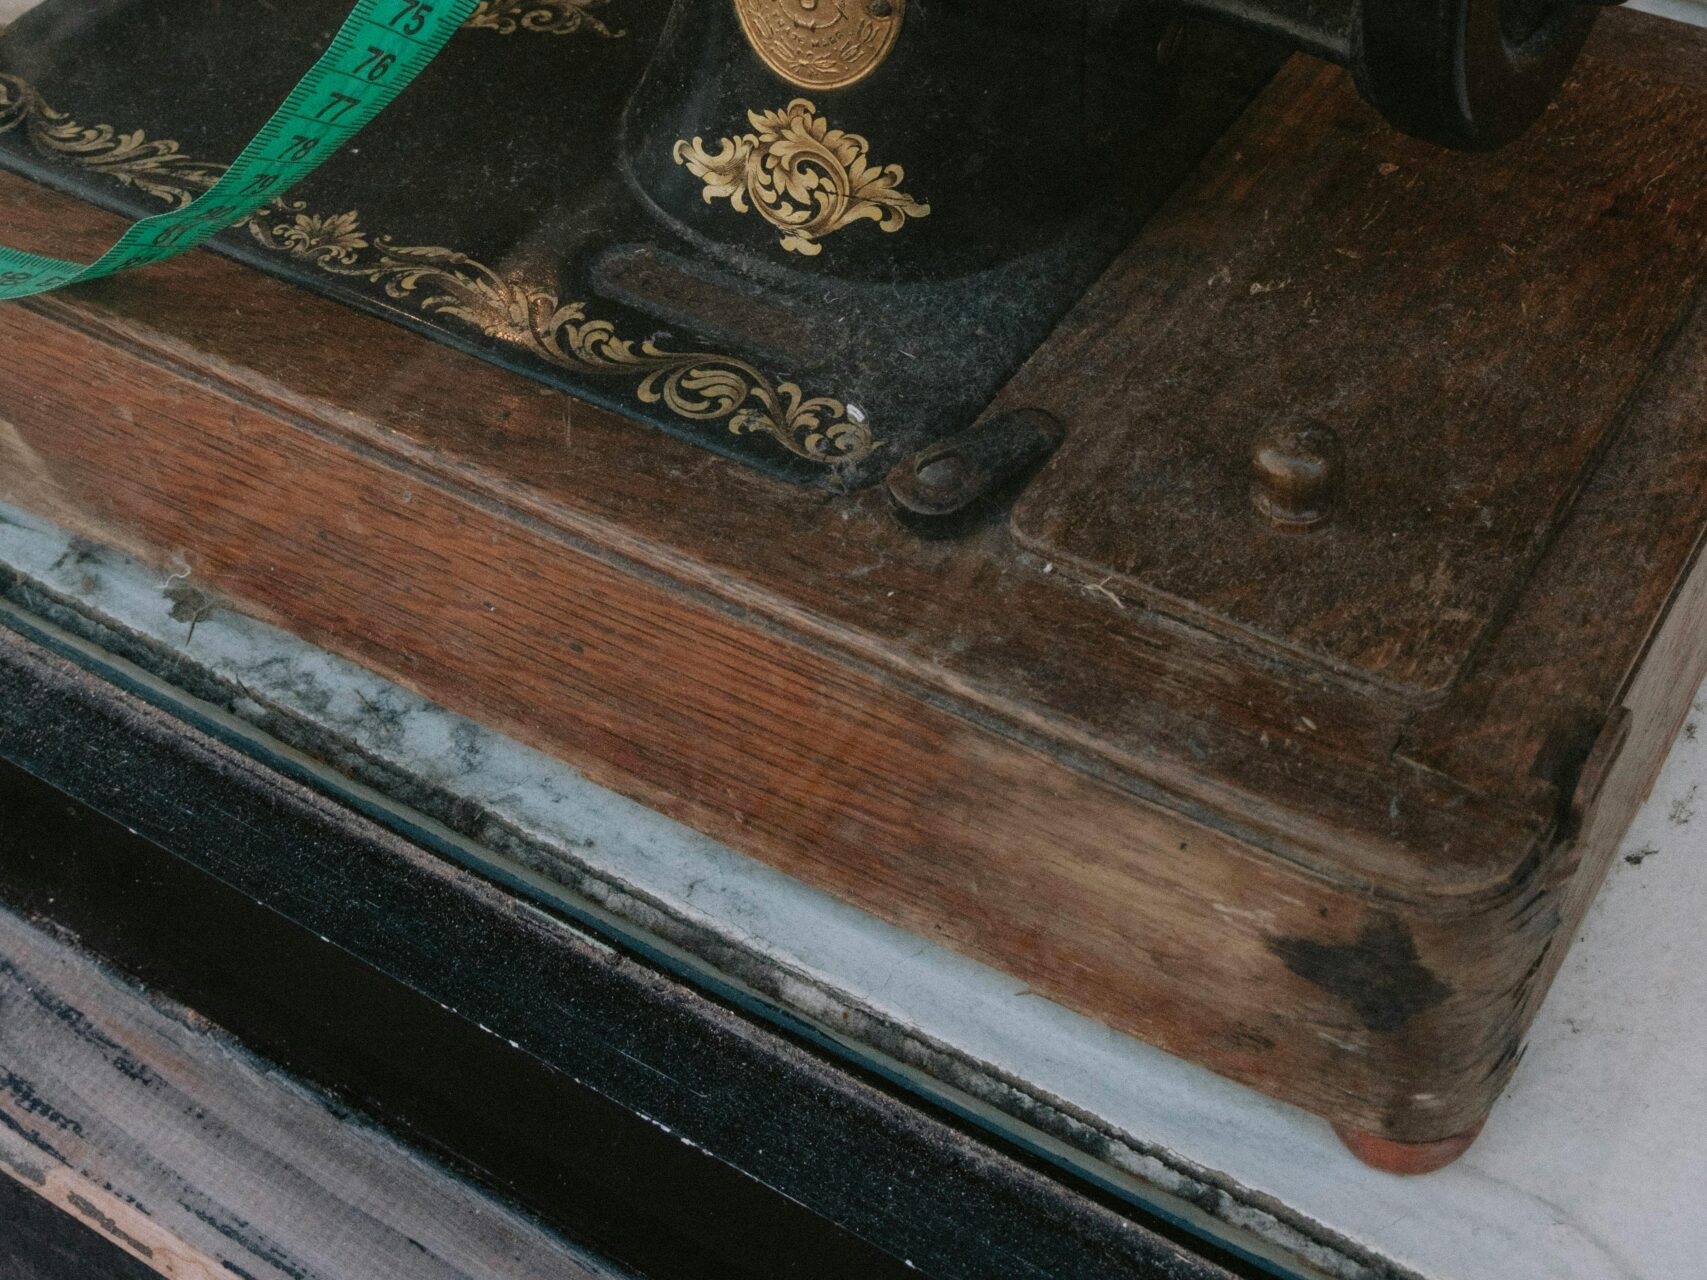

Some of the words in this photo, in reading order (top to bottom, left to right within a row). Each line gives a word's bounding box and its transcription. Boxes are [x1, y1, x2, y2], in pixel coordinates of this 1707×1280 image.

[352, 45, 396, 81] 76
[315, 91, 361, 122] 77
[277, 135, 320, 160] 78
